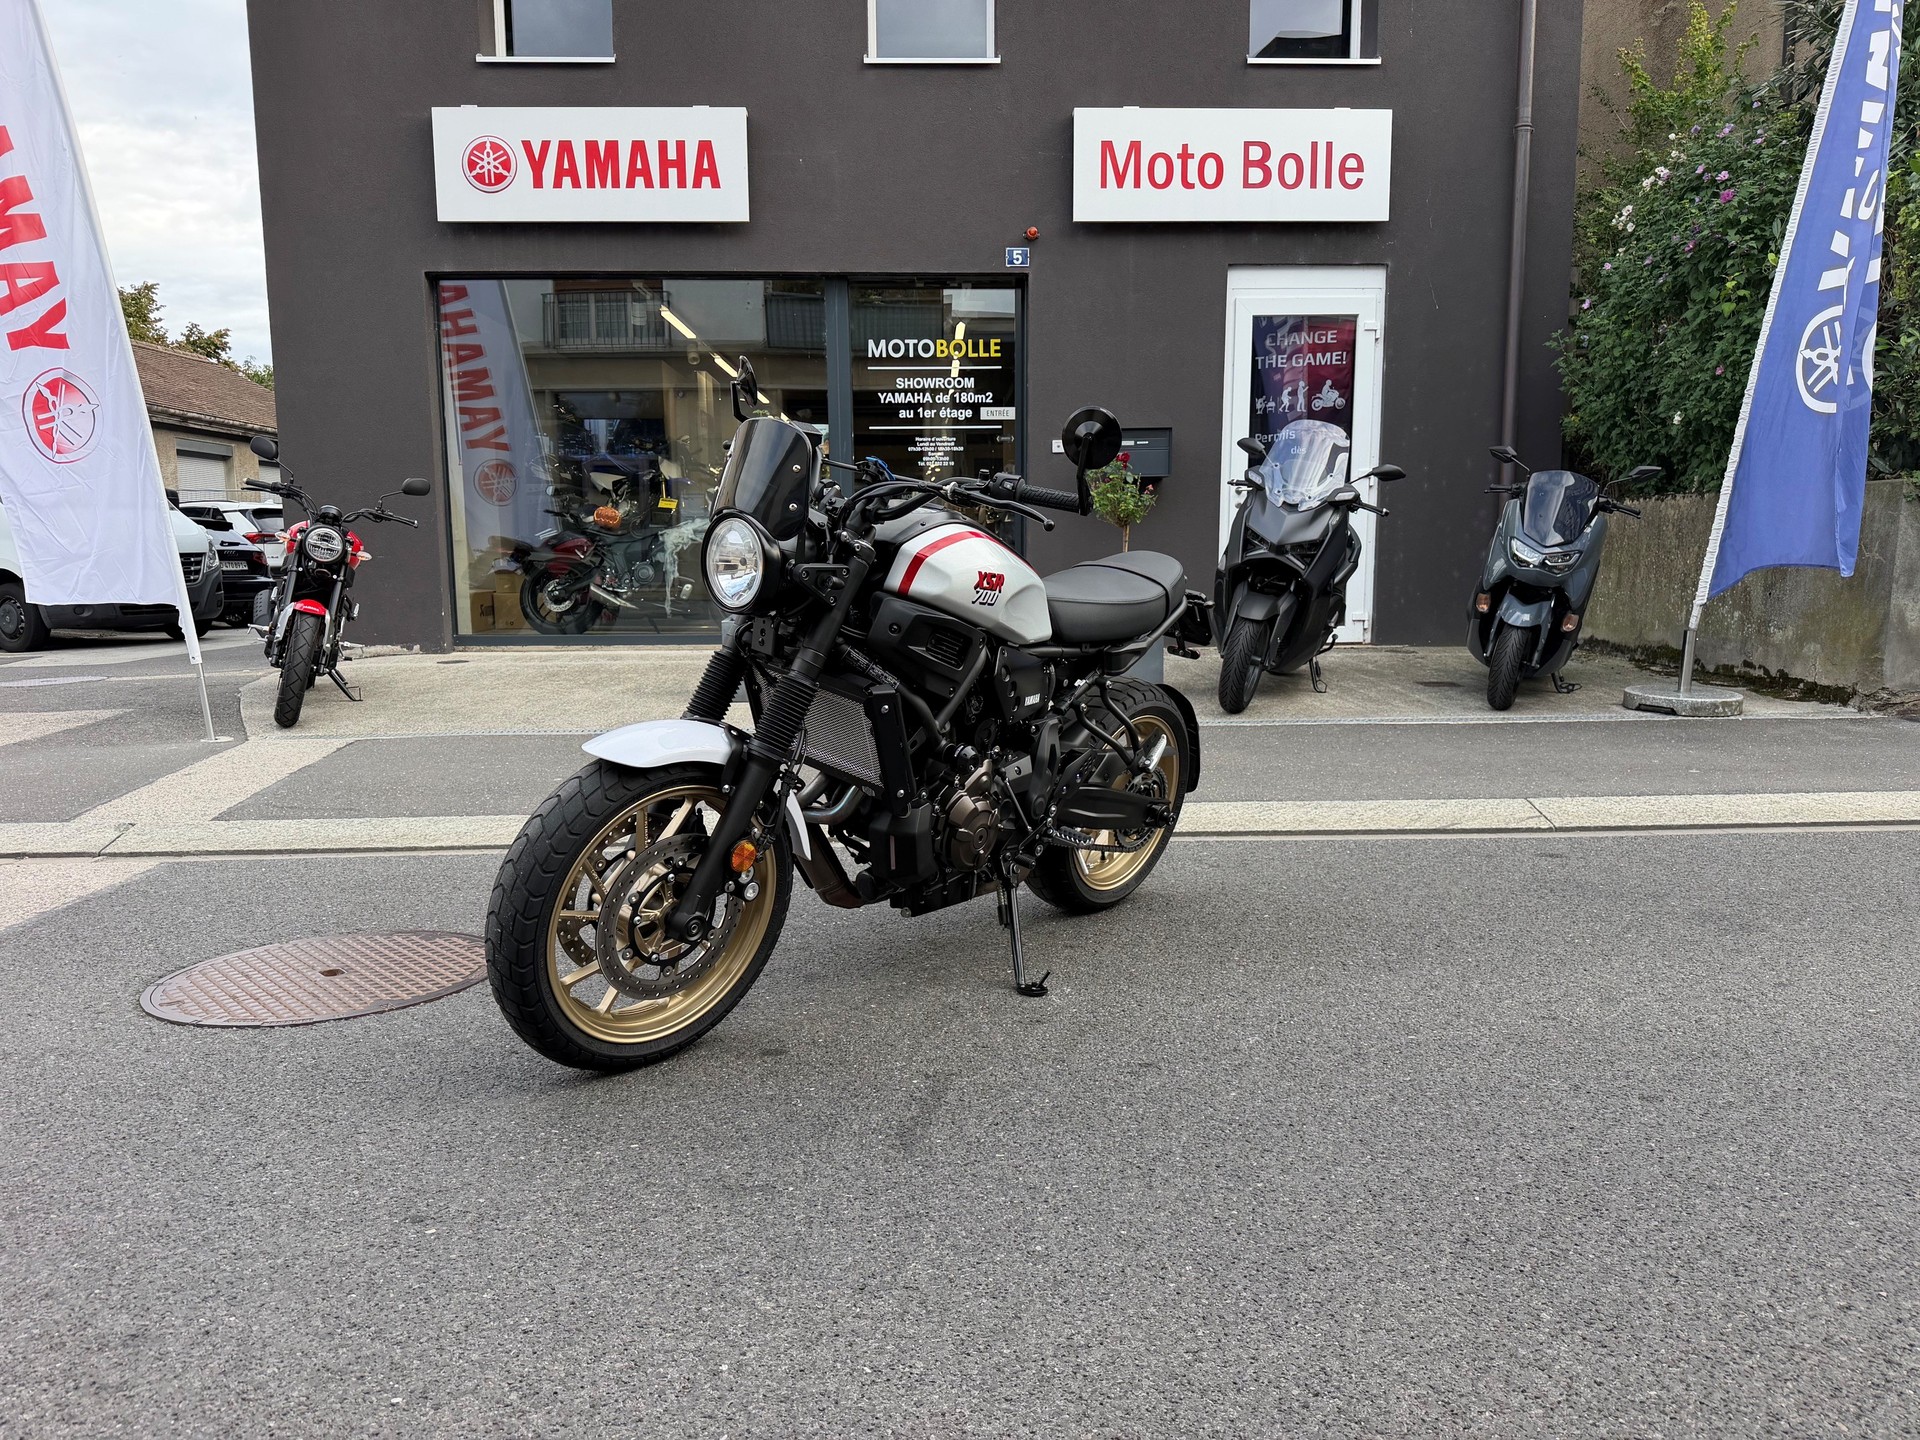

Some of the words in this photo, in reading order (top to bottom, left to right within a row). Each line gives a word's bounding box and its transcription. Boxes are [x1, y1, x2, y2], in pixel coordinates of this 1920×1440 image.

[521, 139, 721, 189] YAMAHA
[1100, 140, 1224, 190] Moto
[1242, 140, 1365, 190] Bolle
[1013, 250, 1023, 265] 5
[1265, 330, 1338, 346] CHANGE
[867, 338, 1002, 358] MOTOBOLLE
[1255, 354, 1288, 369] THE
[1291, 351, 1347, 367] GAME!
[895, 377, 975, 389] SHOWROOM
[878, 392, 933, 404] YAMAHA
[935, 392, 950, 403] de
[953, 391, 993, 403] 180m2
[898, 409, 914, 418] au
[917, 407, 936, 418] 1er
[939, 406, 973, 420] étage
[986, 408, 1010, 417] ENTRÉE
[1255, 429, 1296, 443] Permis
[1290, 445, 1307, 455] dès
[974, 571, 1005, 593] XSR
[971, 589, 1001, 606] 700
